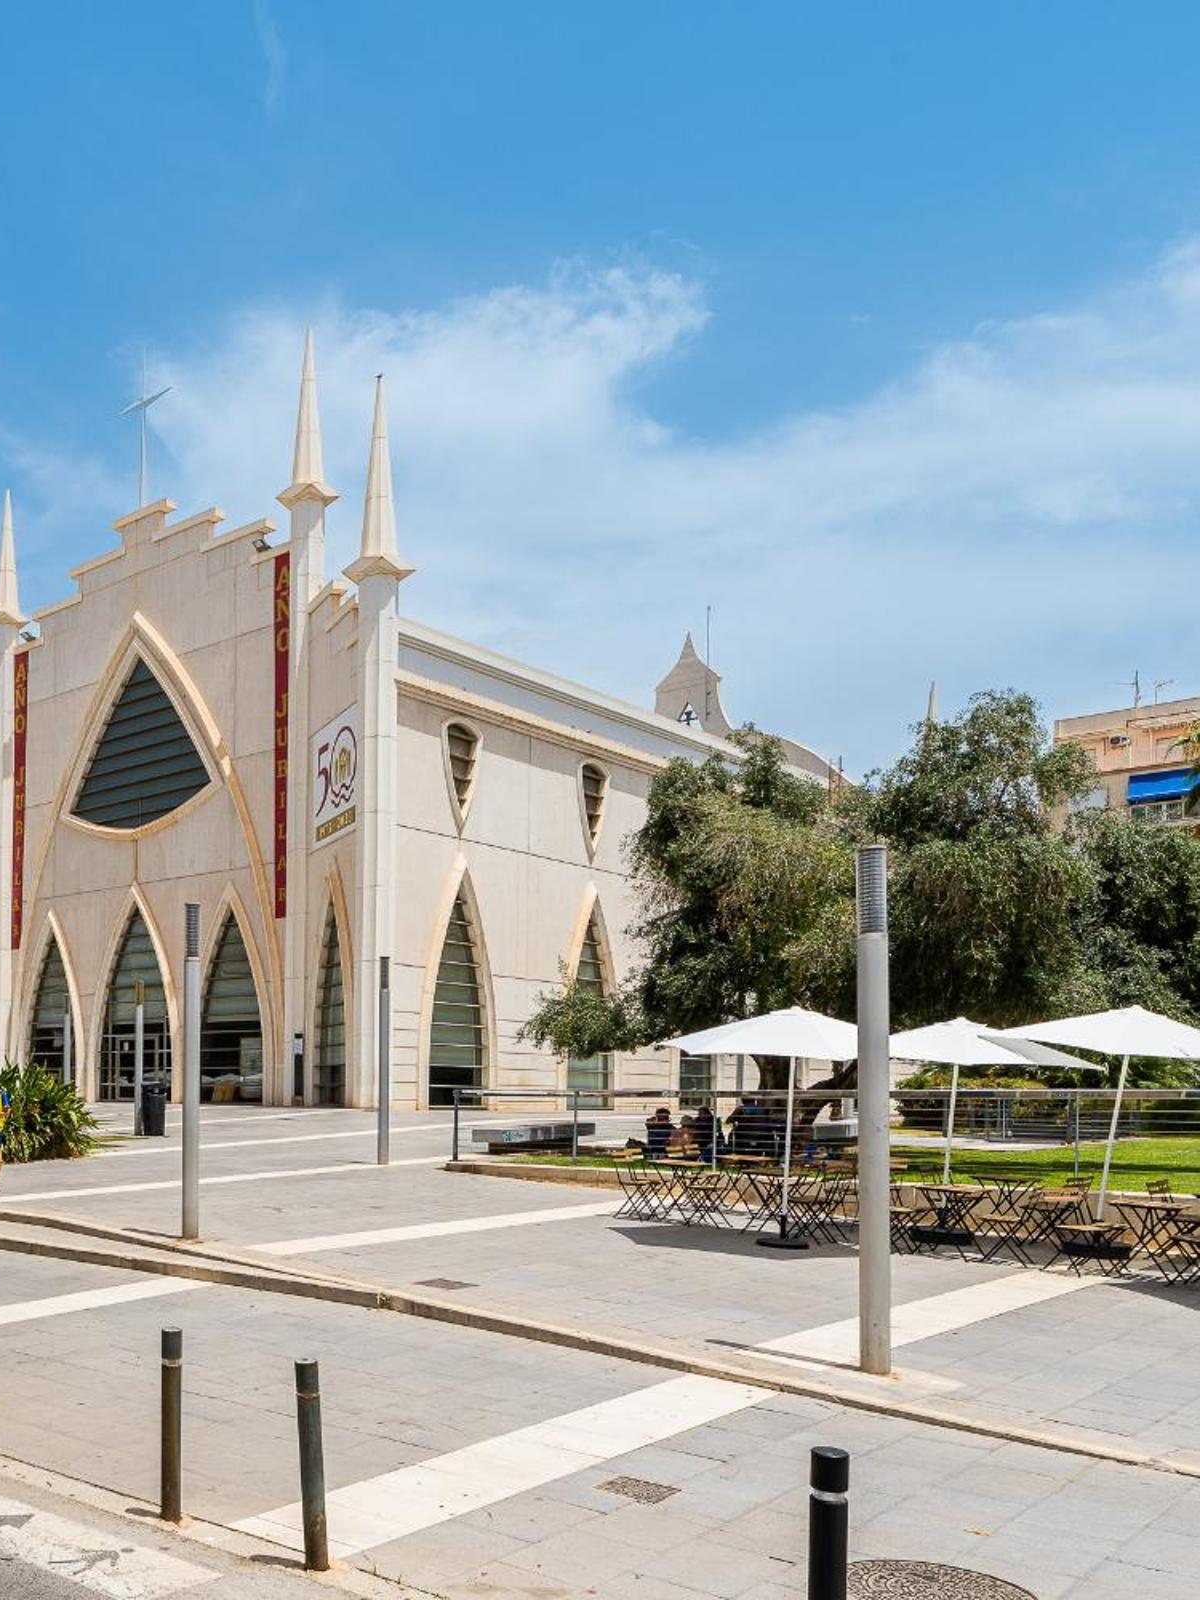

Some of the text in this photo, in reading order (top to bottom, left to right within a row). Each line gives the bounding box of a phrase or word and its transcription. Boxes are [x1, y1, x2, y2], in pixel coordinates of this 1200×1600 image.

[12, 664, 27, 936] AÑO JUBILAR
[276, 565, 289, 902] AÑO JUBILAR
